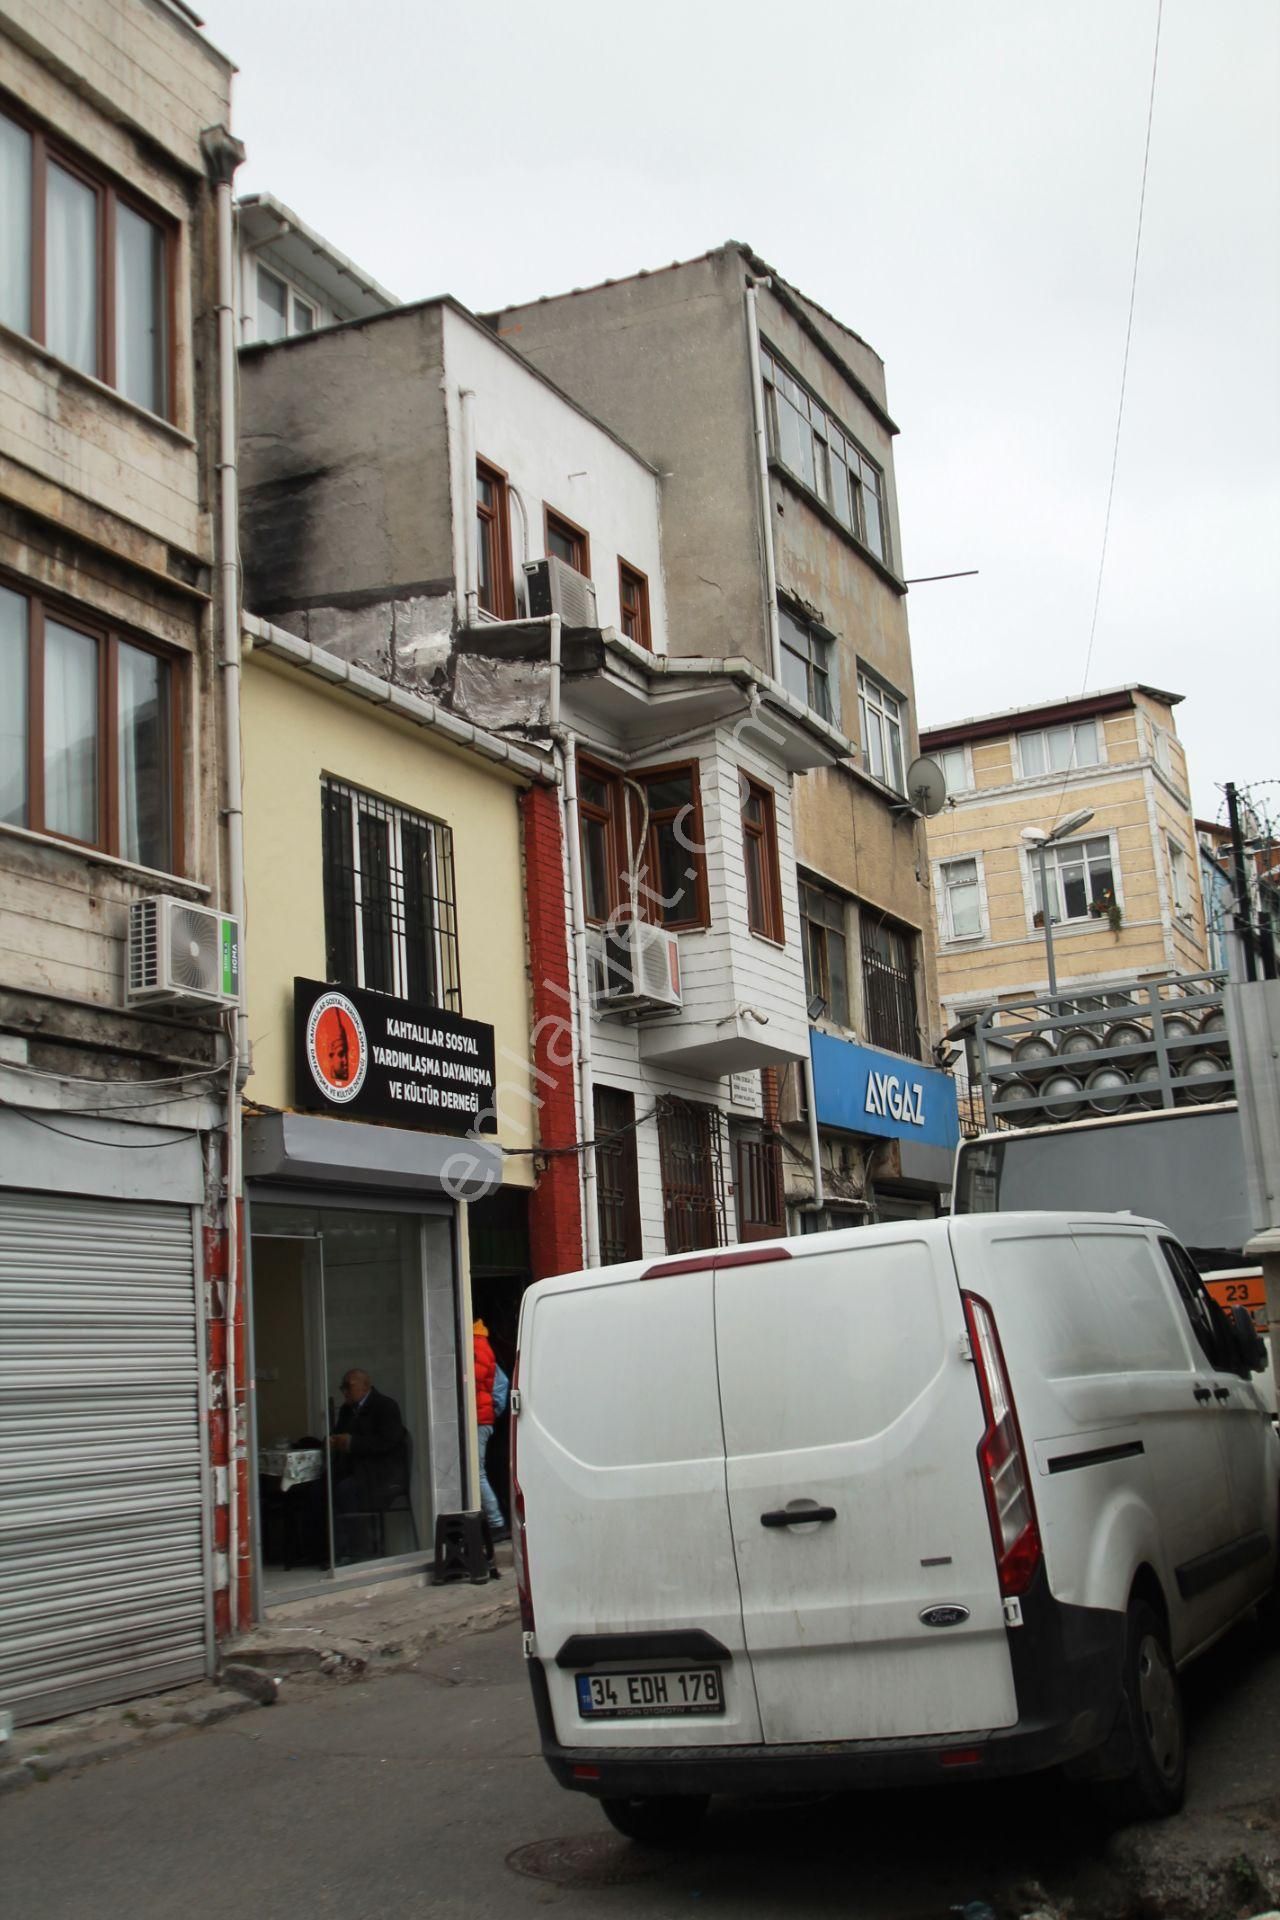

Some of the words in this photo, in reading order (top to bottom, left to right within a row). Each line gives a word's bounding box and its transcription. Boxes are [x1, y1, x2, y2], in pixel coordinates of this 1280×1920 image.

[386, 1017, 444, 1048] KAHTALILAR
[445, 1032, 479, 1055] SOSYAL
[372, 1045, 441, 1077] YARDIMLAŞMA
[441, 1061, 492, 1087] DAYANIŞMA
[388, 1080, 402, 1099] VE
[403, 1081, 440, 1107] KÜLTÜR
[441, 1091, 479, 1113] DERNEĞİ
[865, 1069, 925, 1126] AYGAZ
[1225, 1284, 1249, 1301] 23
[930, 1610, 958, 1623] Ford
[592, 1679, 617, 1706] 34
[627, 1675, 669, 1704] EDH
[678, 1673, 718, 1702] 178
